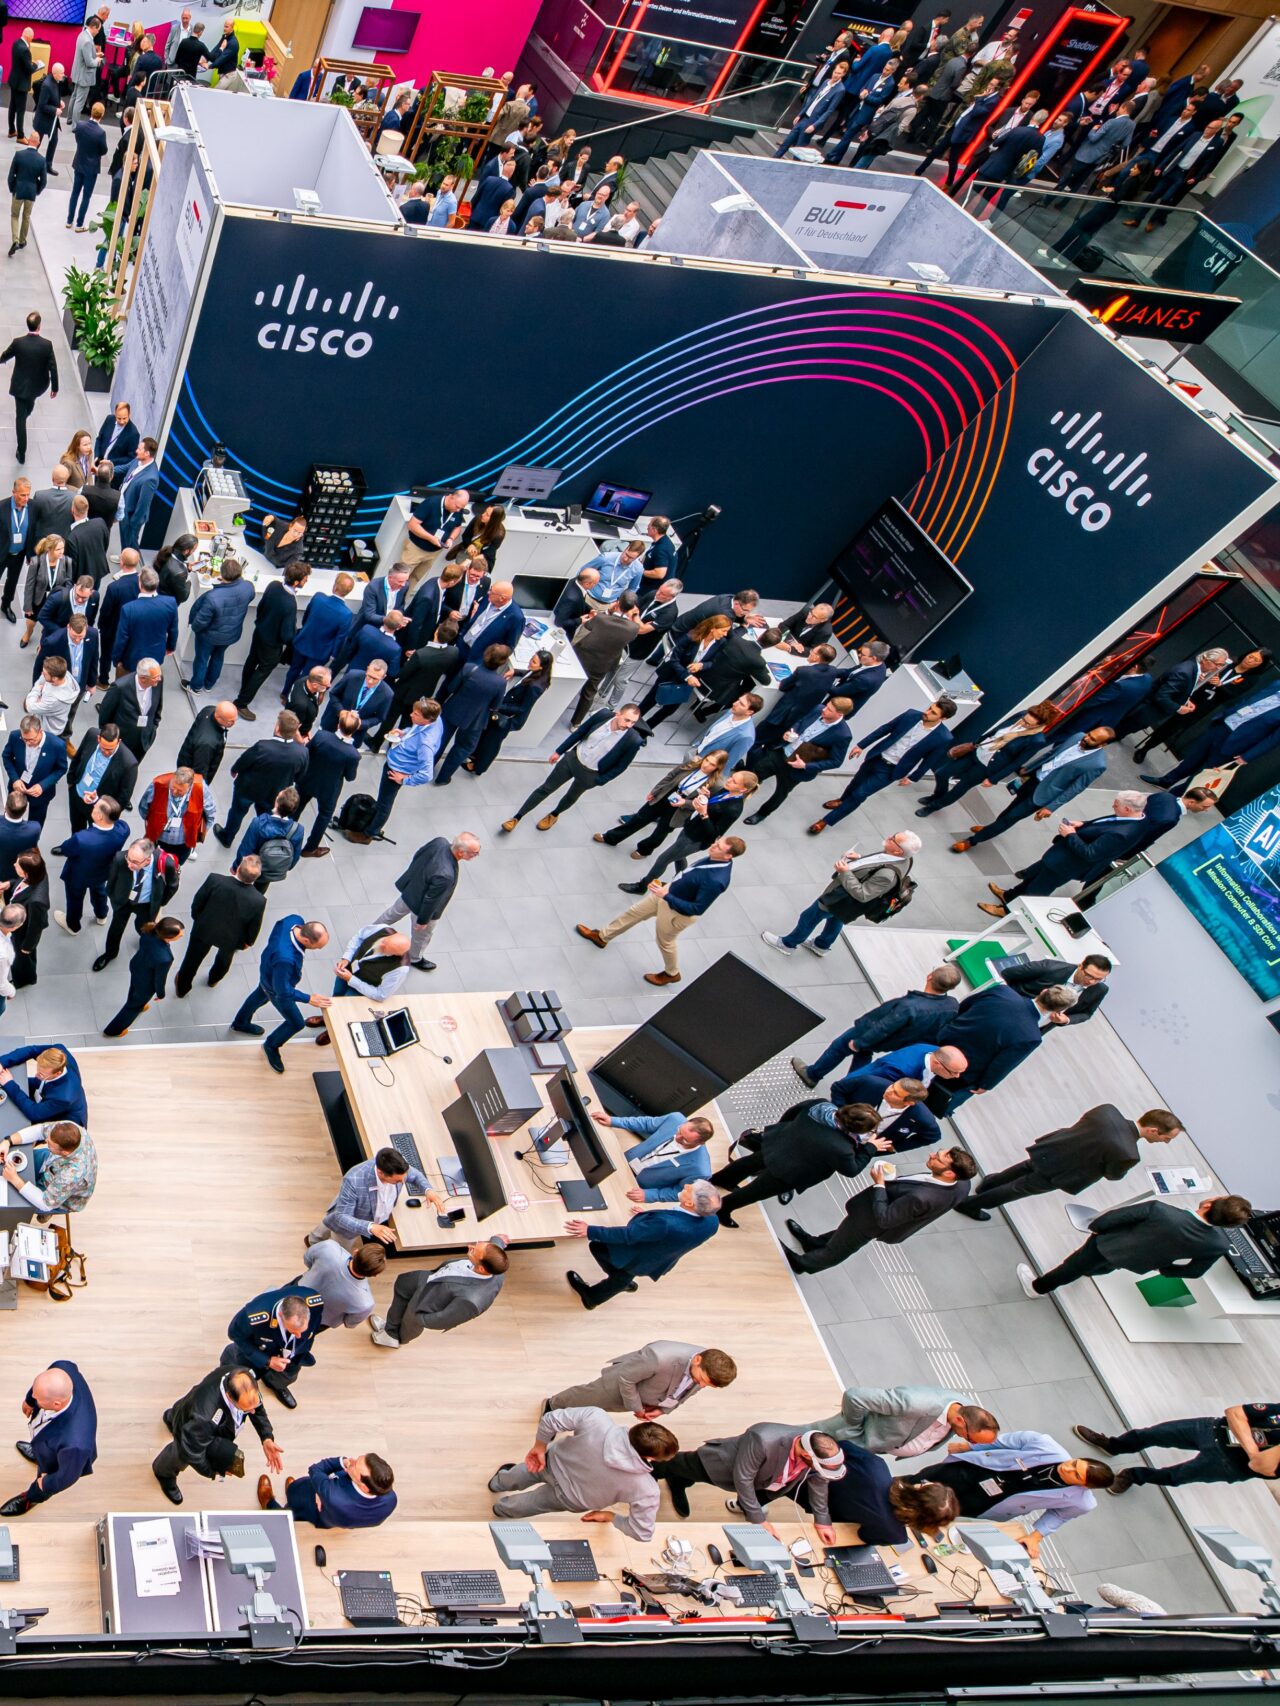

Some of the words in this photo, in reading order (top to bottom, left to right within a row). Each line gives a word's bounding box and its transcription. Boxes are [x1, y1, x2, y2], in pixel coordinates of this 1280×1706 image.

[803, 207, 846, 225] BWI
[795, 226, 803, 236] IT
[803, 226, 817, 237] für
[817, 228, 868, 243] Deutschland
[1115, 304, 1201, 330] JANES
[257, 323, 373, 358] CISCO
[1027, 448, 1111, 532] CISCO
[1253, 824, 1280, 851] AI
[1206, 868, 1227, 892] Mission
[1225, 891, 1251, 923] Computer
[1261, 933, 1276, 951] Core
[1215, 863, 1245, 897] Information
[1242, 895, 1277, 936] Collaboration
